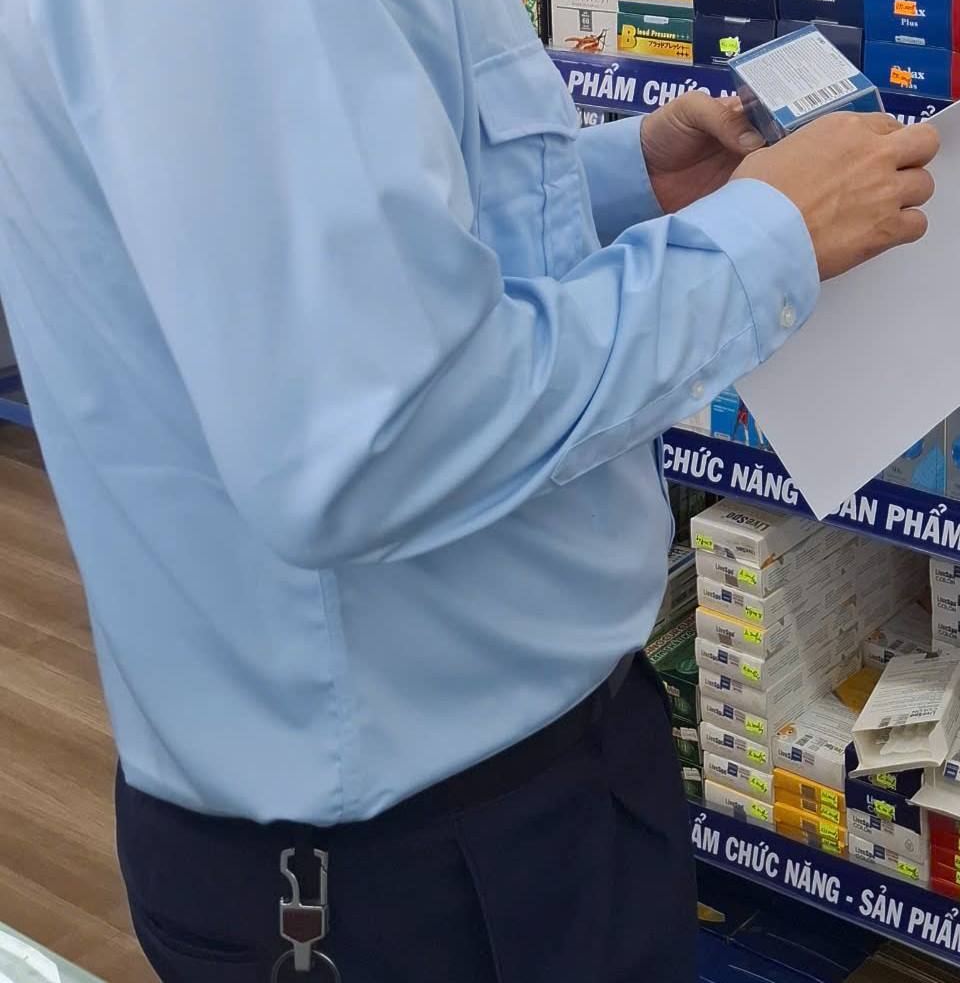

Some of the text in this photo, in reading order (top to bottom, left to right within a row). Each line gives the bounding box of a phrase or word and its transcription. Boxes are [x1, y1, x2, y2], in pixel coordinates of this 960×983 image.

[901, 19, 918, 28] Plus
[568, 63, 636, 102] PHẨM
[662, 444, 725, 482] CHỨC
[730, 463, 800, 506] NĂNG
[726, 840, 778, 877] CHỨC
[784, 861, 841, 904] NĂNG
[859, 885, 901, 928] SẢN
